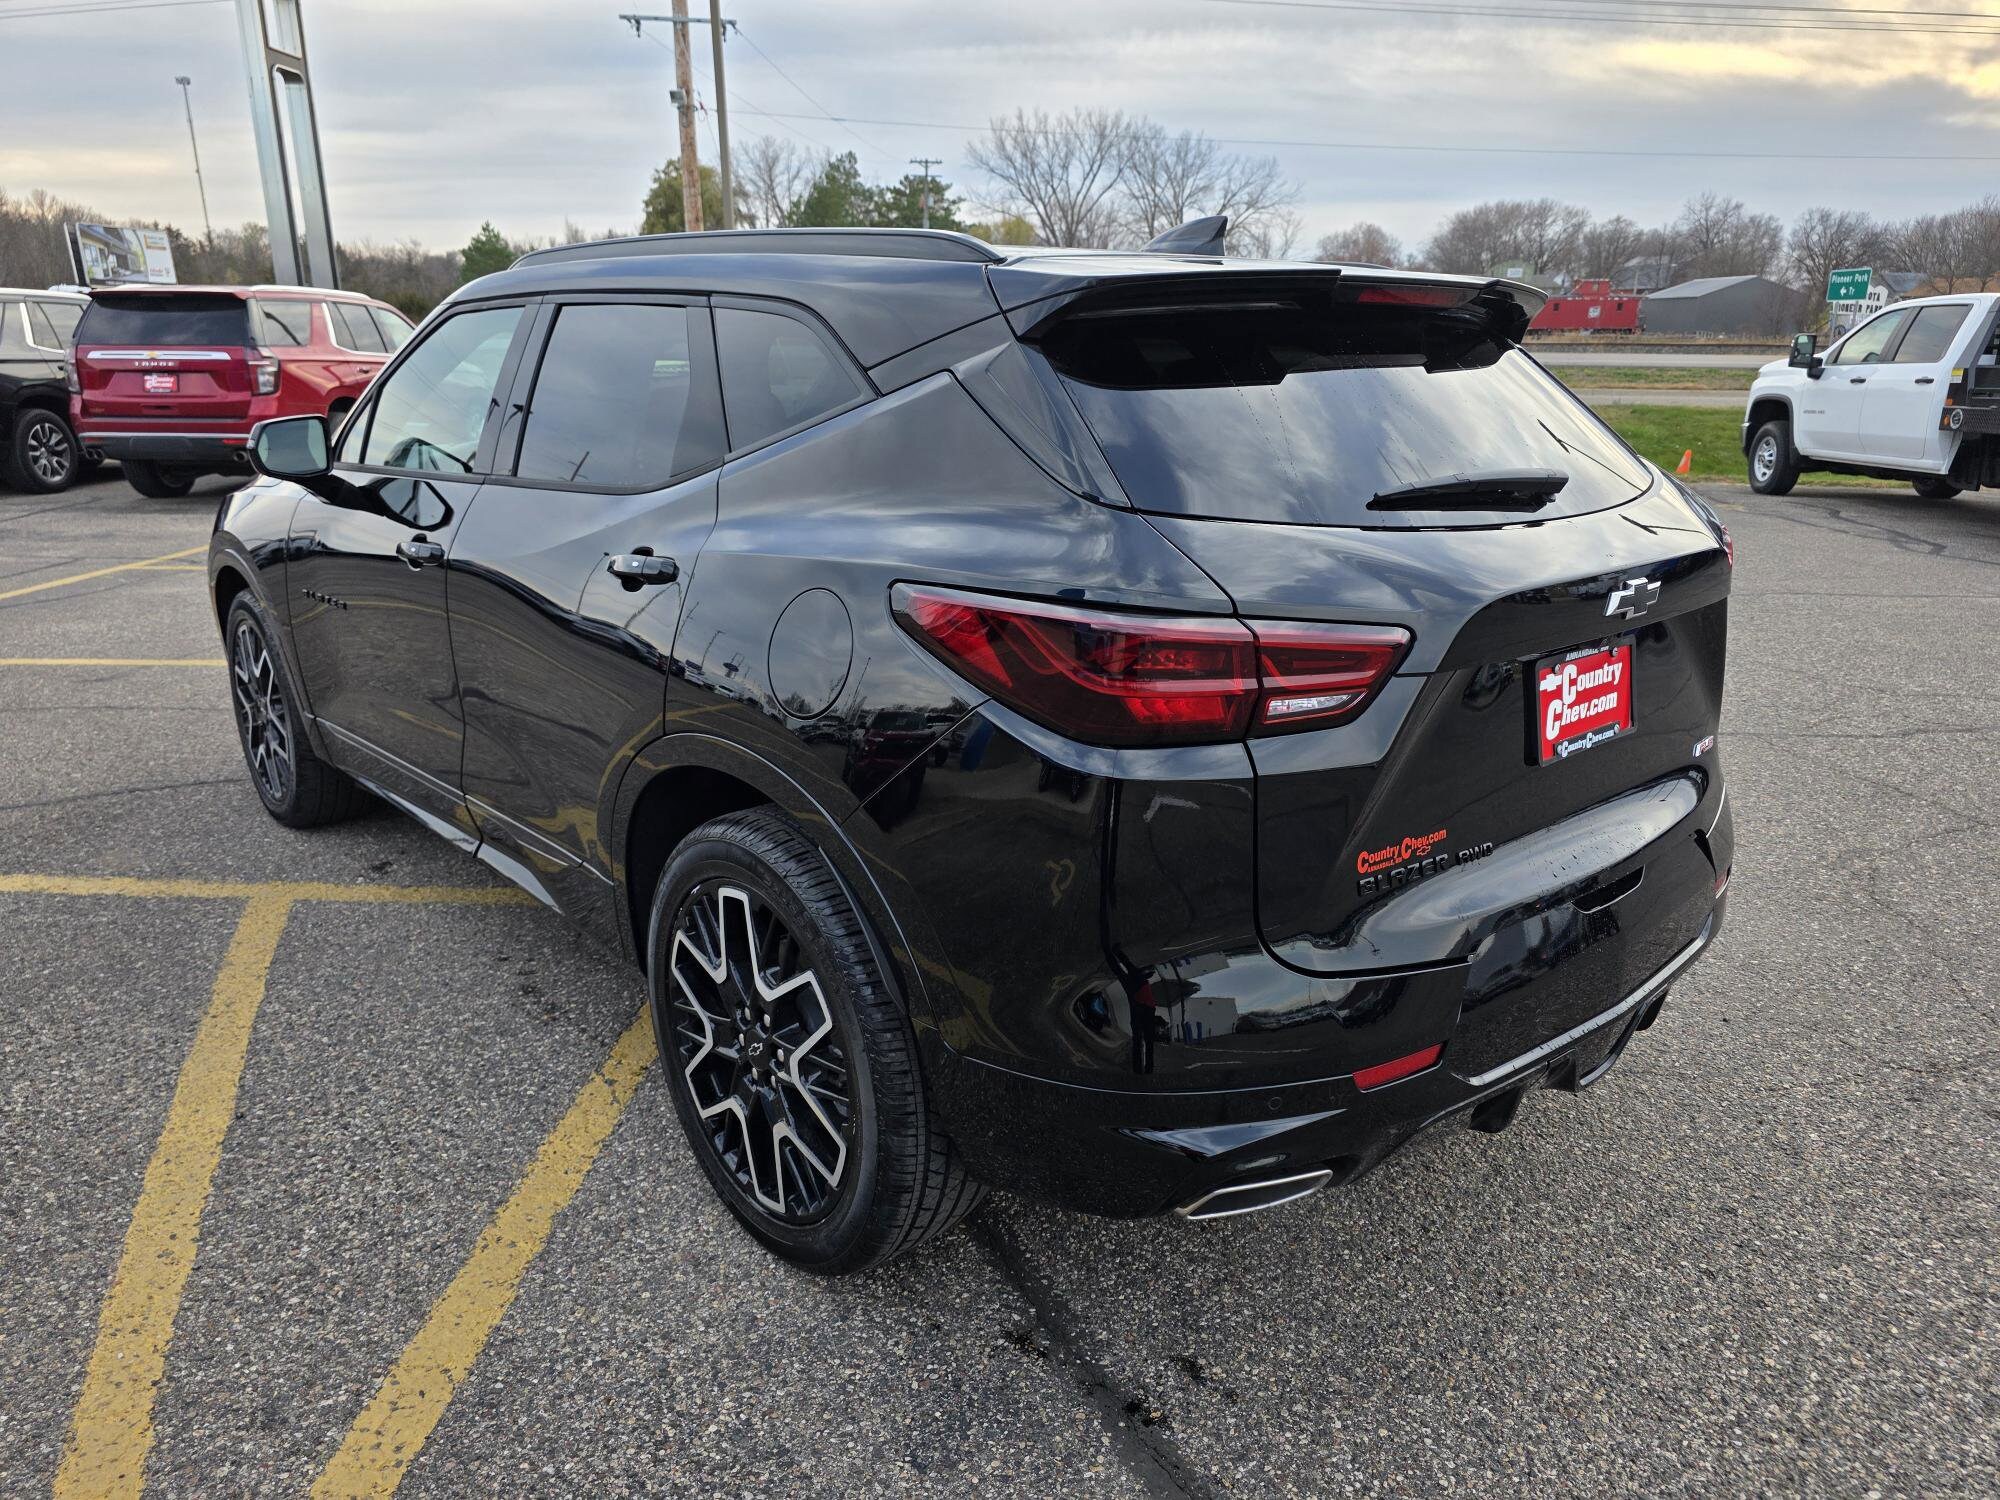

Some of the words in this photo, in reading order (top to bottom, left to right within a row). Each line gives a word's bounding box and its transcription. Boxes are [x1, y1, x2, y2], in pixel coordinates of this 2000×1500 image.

[1831, 274, 1853, 284] Pioneer
[1854, 272, 1868, 282] Park
[1562, 663, 1623, 705] Country
[1546, 692, 1618, 741] Chev.com
